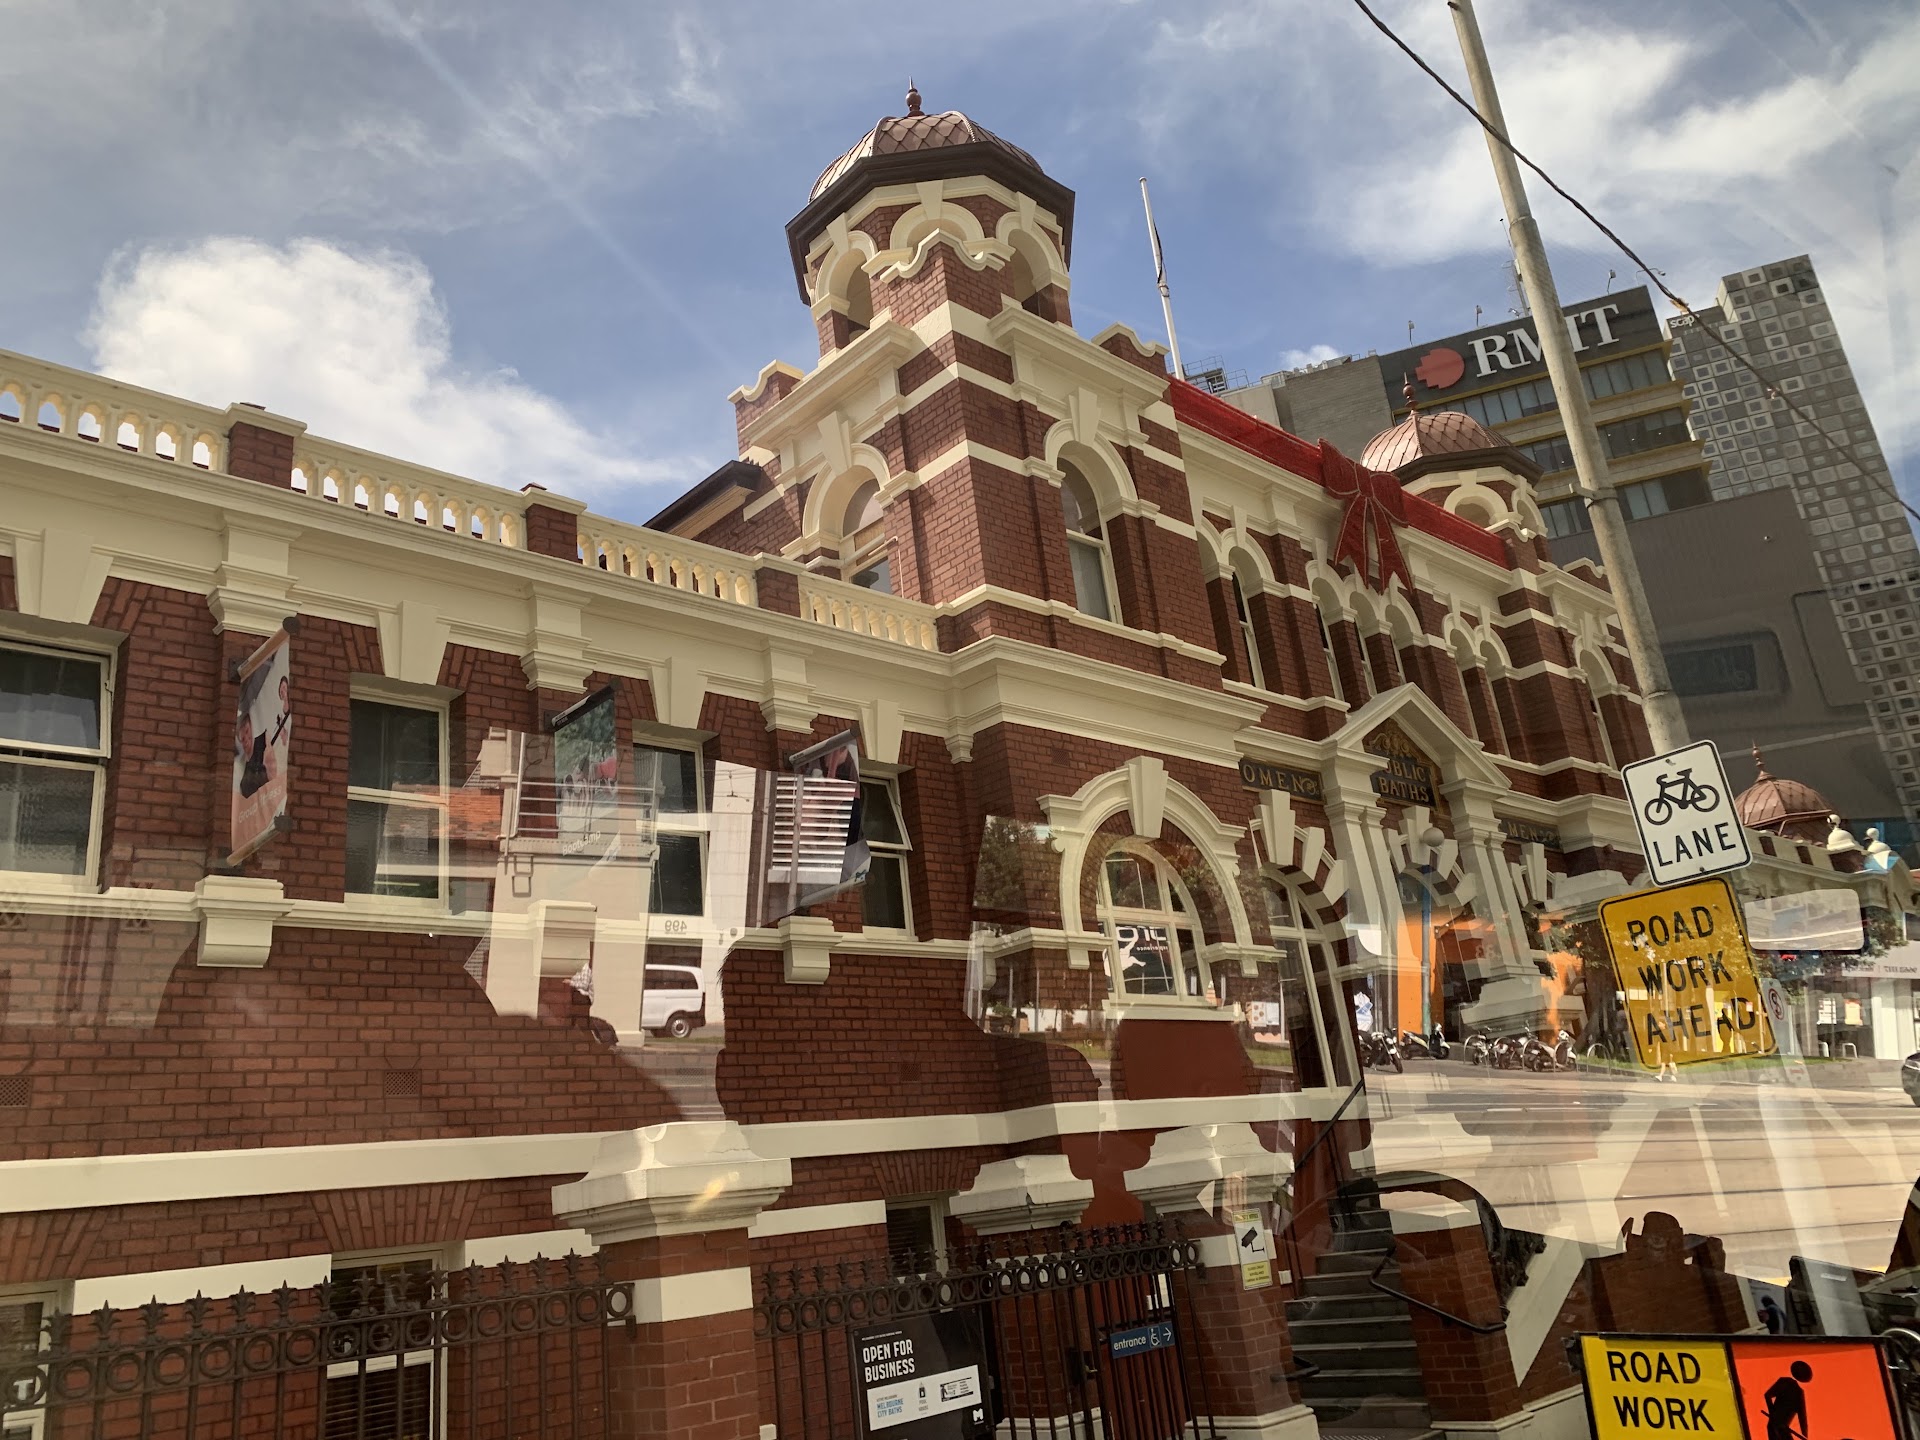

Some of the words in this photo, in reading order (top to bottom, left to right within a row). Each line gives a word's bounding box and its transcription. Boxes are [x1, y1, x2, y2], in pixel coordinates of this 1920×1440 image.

[1669, 312, 1701, 329] scap
[1467, 303, 1620, 378] RMIT
[1243, 764, 1305, 793] OMEN
[1379, 776, 1430, 803] BATHS
[1653, 822, 1737, 867] LANE
[1626, 906, 1714, 952] ROAD
[1637, 950, 1734, 997] WORK
[1646, 997, 1756, 1046] AHEAD
[862, 1343, 892, 1364] OPEN
[893, 1338, 914, 1358] FOR
[1113, 1336, 1147, 1351] entrance
[864, 1357, 916, 1383] BUSINESS
[1606, 1350, 1701, 1385] ROAD
[877, 1409, 888, 1418] CITY
[1613, 1395, 1716, 1432] WORK
